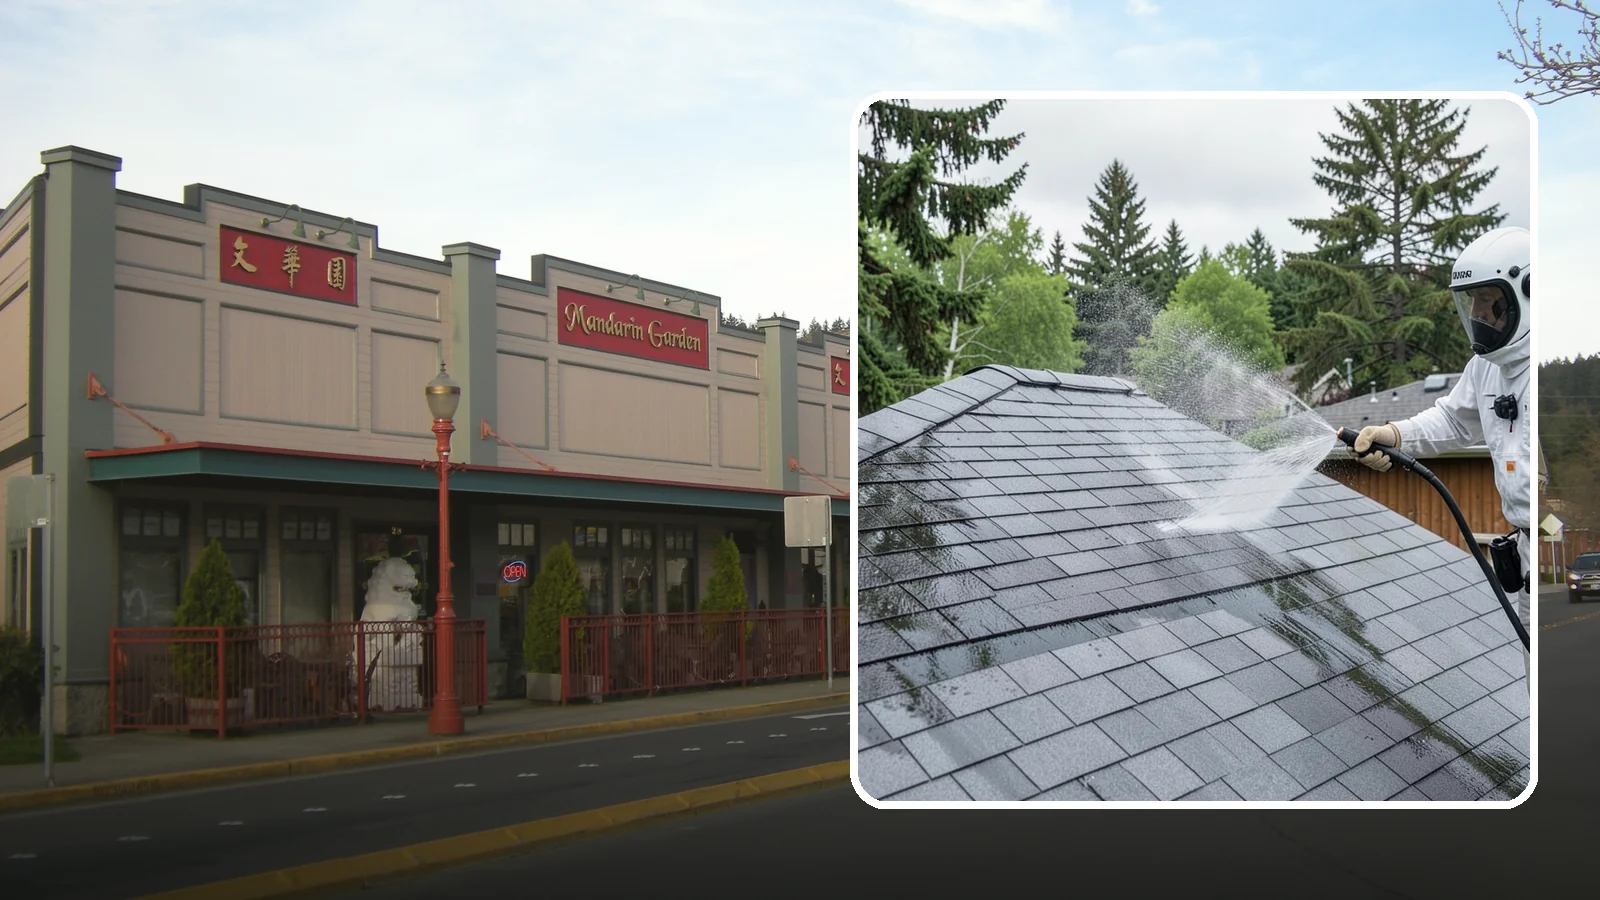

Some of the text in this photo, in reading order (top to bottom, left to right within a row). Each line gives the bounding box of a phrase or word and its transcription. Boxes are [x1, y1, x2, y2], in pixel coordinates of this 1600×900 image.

[231, 235, 346, 290] 文華園
[565, 302, 702, 352] Mandarin Garden
[503, 565, 527, 578] OPEN
